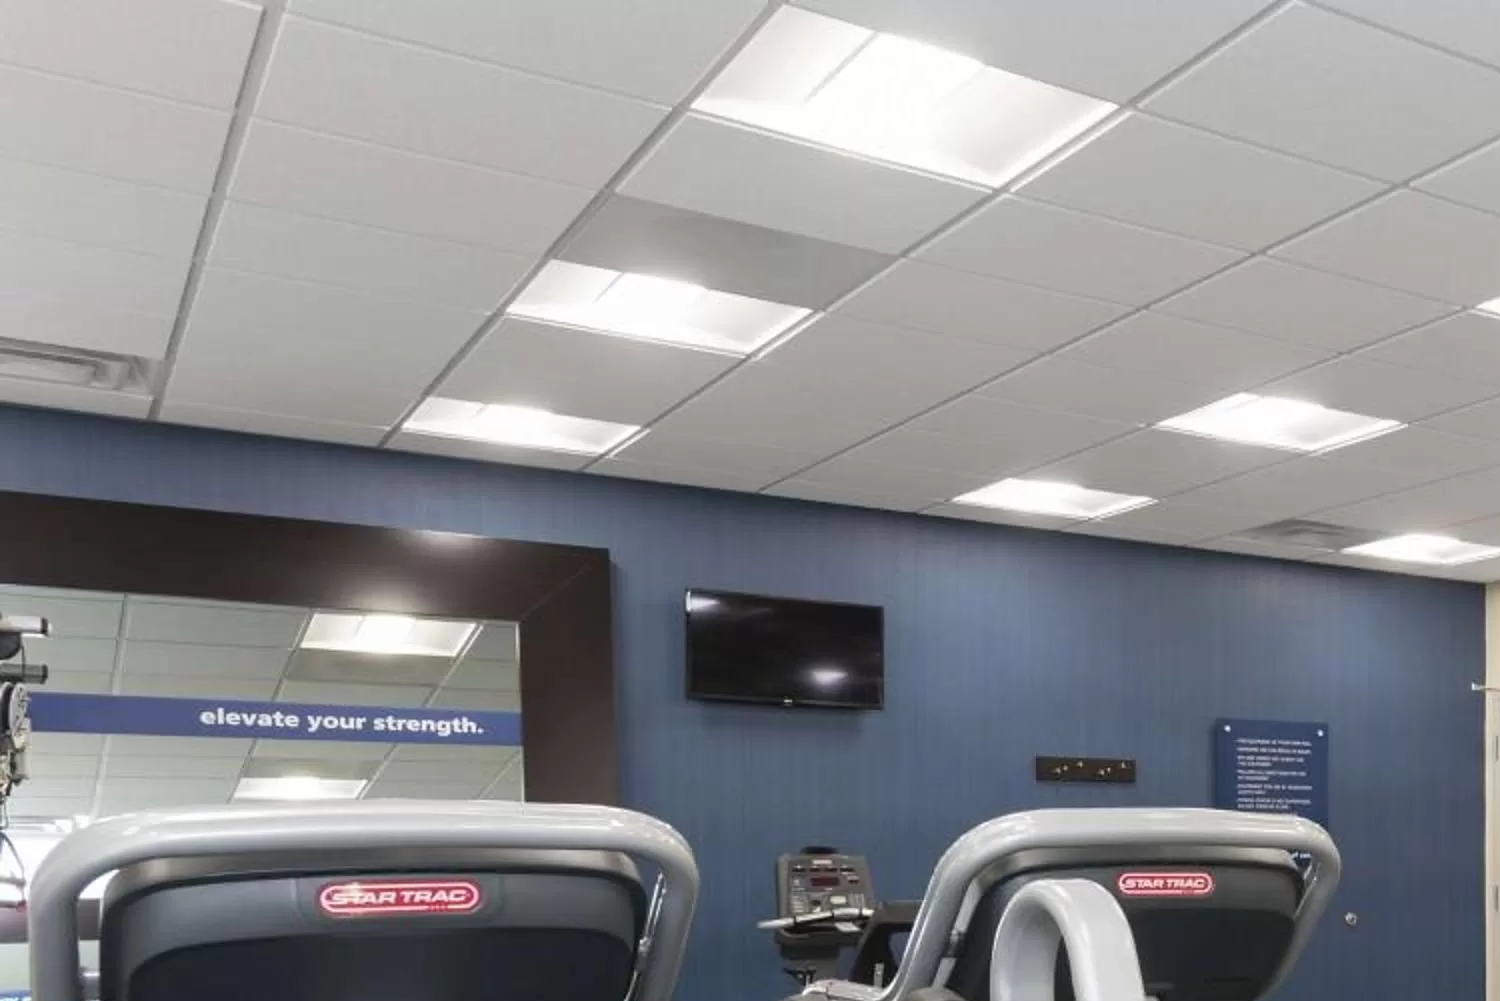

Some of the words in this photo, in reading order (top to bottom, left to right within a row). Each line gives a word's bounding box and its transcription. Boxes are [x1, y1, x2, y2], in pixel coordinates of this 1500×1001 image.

[200, 708, 299, 728] elevate
[307, 715, 366, 733] your
[373, 714, 485, 737] strength.
[1125, 878, 1165, 889] STAR
[1166, 878, 1206, 889] TRAC
[331, 891, 397, 905] STAR
[401, 888, 467, 904] TRAC
